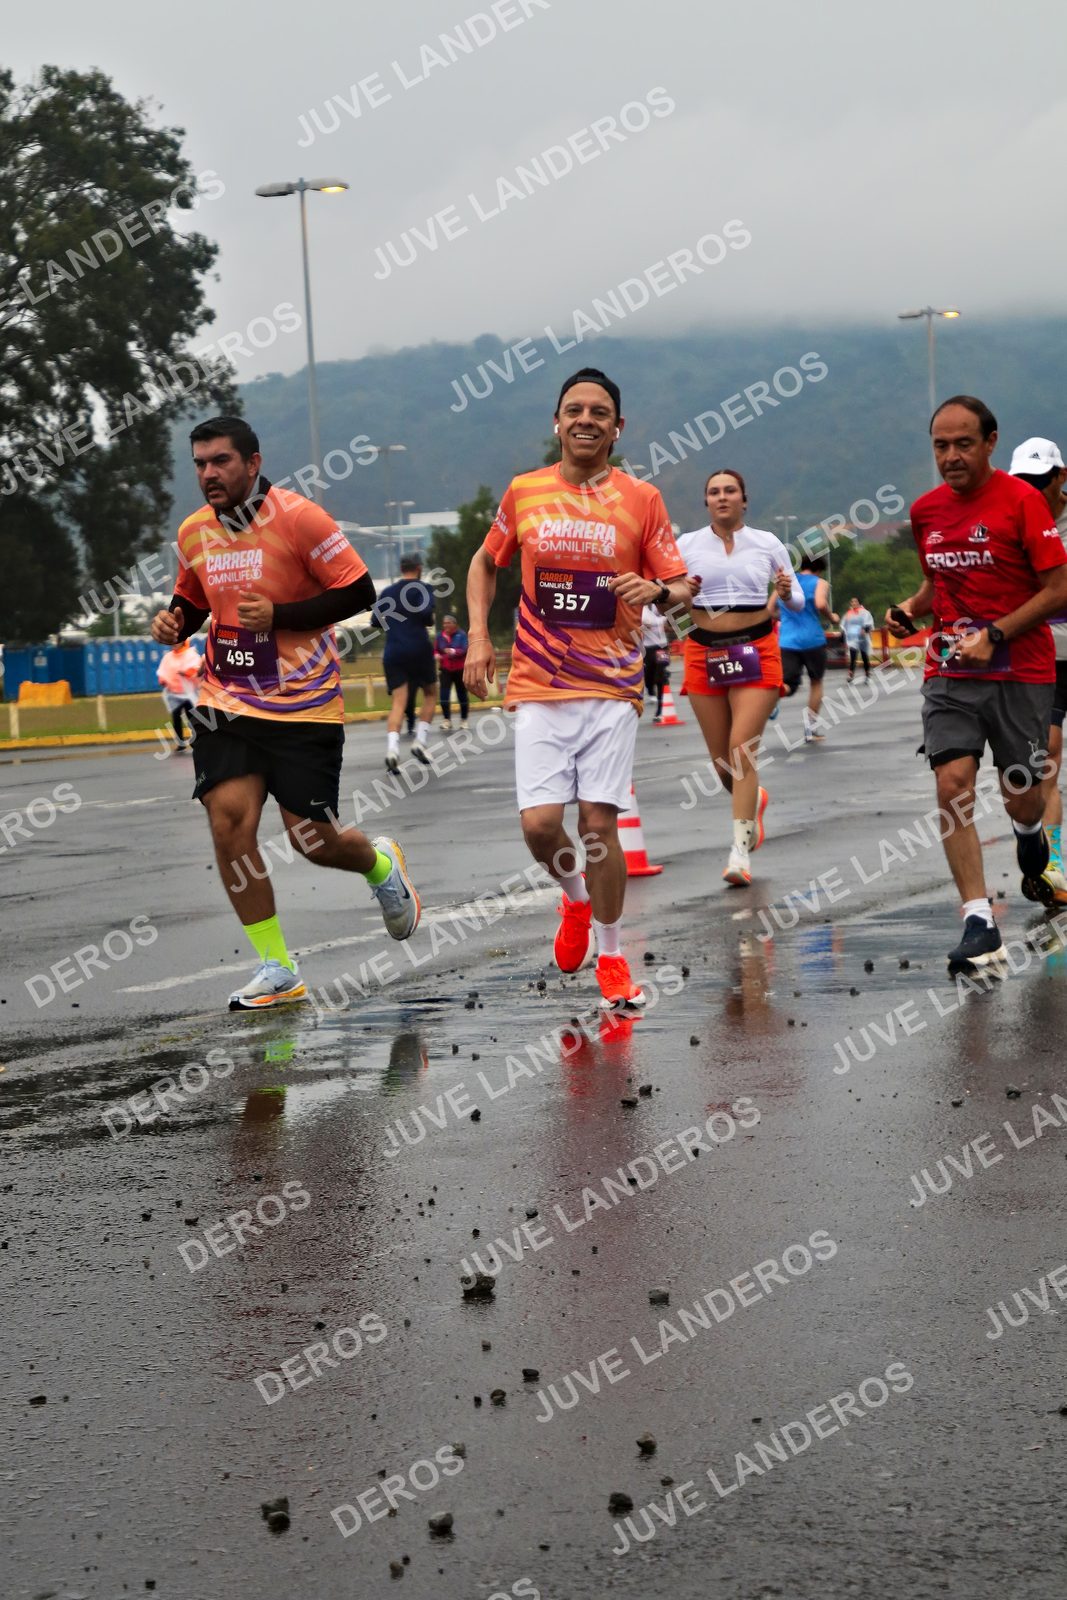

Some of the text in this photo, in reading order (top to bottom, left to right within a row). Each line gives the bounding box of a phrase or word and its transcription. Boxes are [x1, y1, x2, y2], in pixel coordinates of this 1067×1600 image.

[538, 519, 616, 544] CARRERA
[538, 539, 598, 554] OMNILIFE
[206, 548, 263, 572] CARRERA
[207, 569, 251, 586] OMNILIFE
[540, 572, 574, 583] CARRERA
[553, 592, 590, 611] 357
[226, 649, 255, 667] 495
[718, 660, 743, 675] 134
